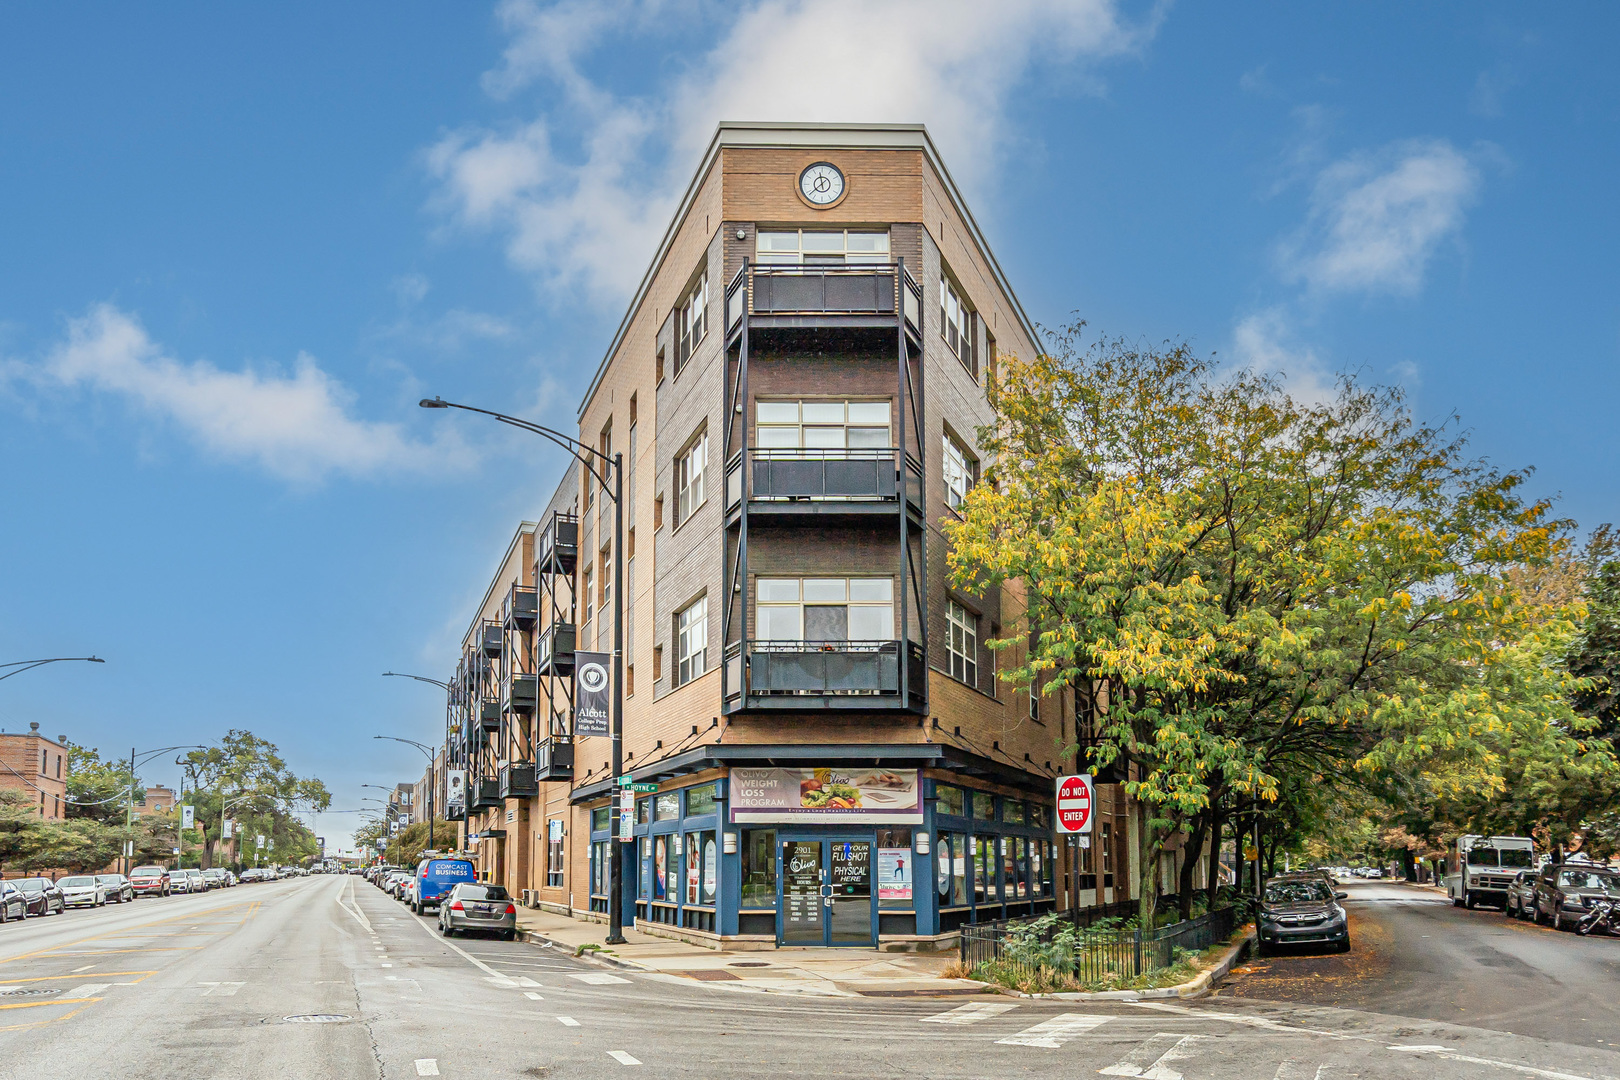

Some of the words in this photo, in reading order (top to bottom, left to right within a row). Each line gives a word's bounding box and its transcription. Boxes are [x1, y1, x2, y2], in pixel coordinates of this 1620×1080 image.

[578, 707, 607, 718] Alcott
[740, 770, 768, 778] OLIVO
[822, 771, 850, 786] Olivo
[740, 780, 778, 788] WEIGHT
[741, 789, 764, 797] LOSS
[1061, 788, 1070, 797] DO
[1072, 786, 1086, 796] NOT
[740, 798, 785, 806] PROGRAM
[1064, 812, 1084, 821] ENTER
[832, 852, 846, 861] FLU
[847, 852, 868, 861] SHOT
[790, 856, 816, 872] Olivo
[834, 866, 867, 876] PHYSICAL
